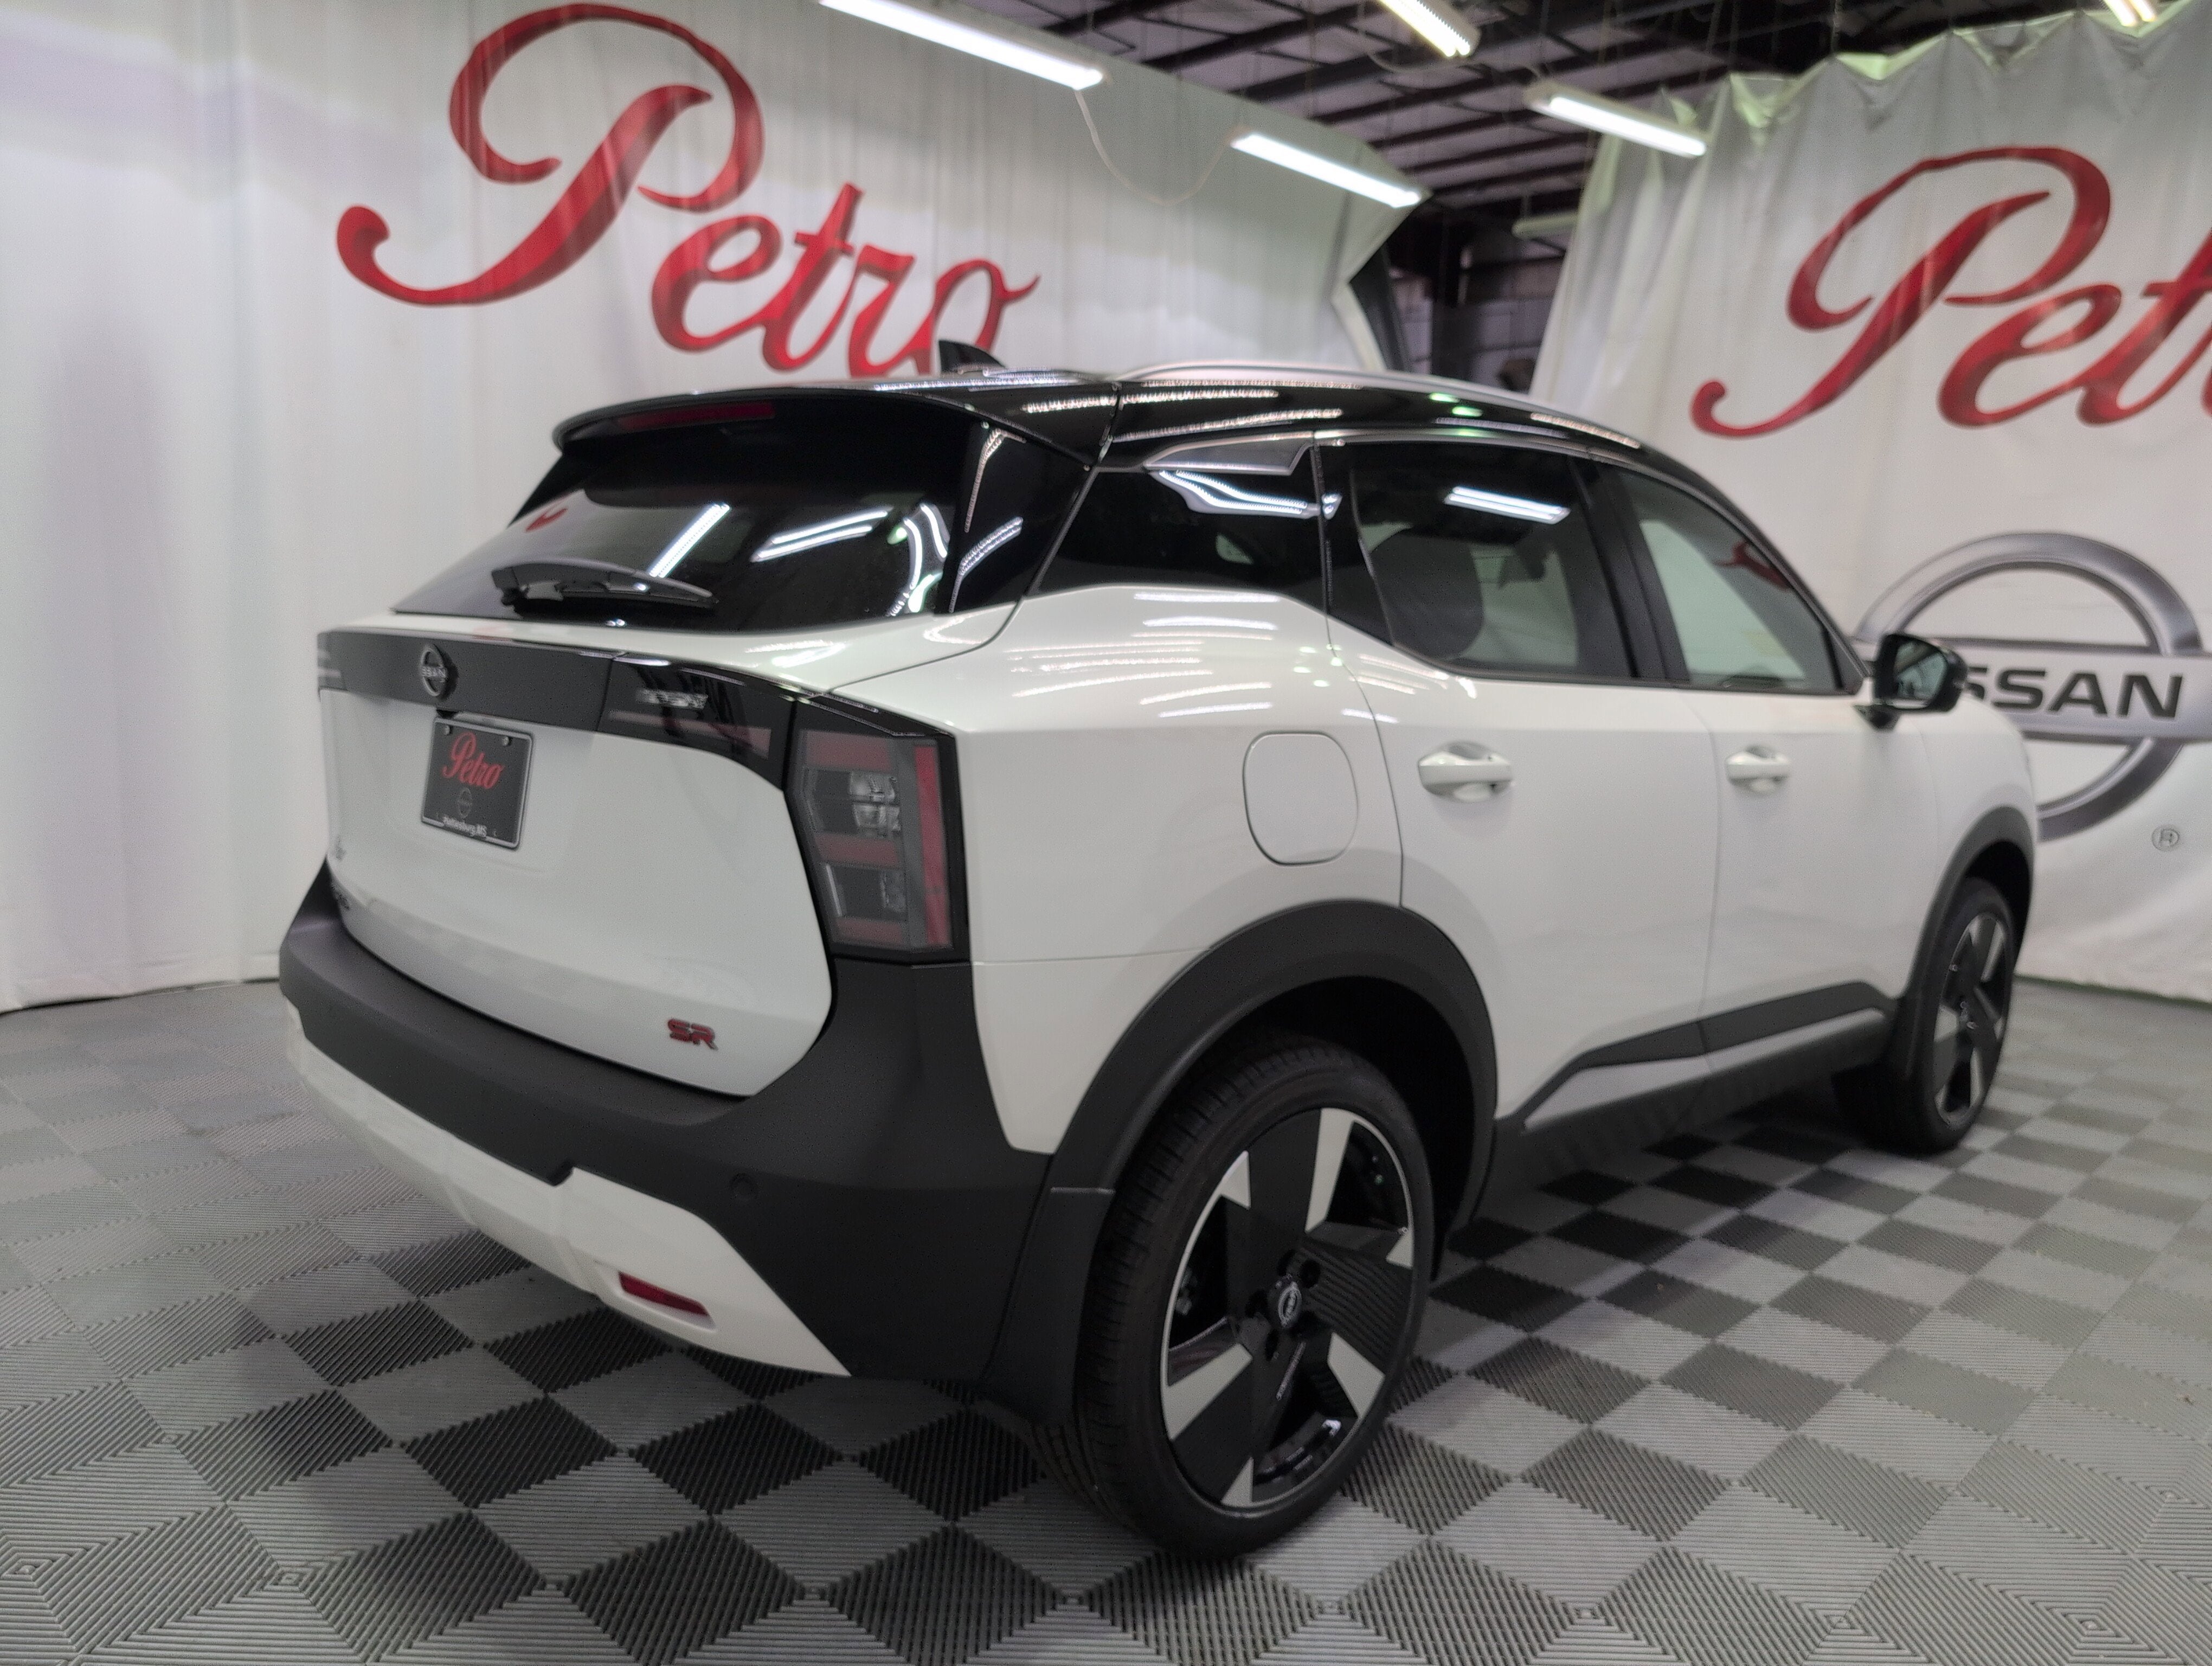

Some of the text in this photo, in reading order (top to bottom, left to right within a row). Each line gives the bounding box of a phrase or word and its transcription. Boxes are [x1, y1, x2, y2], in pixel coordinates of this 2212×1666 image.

[337, 2, 1040, 377] Petro
[1690, 146, 2212, 439] Pet
[442, 732, 505, 789] Petro
[667, 1018, 718, 1050] SR
